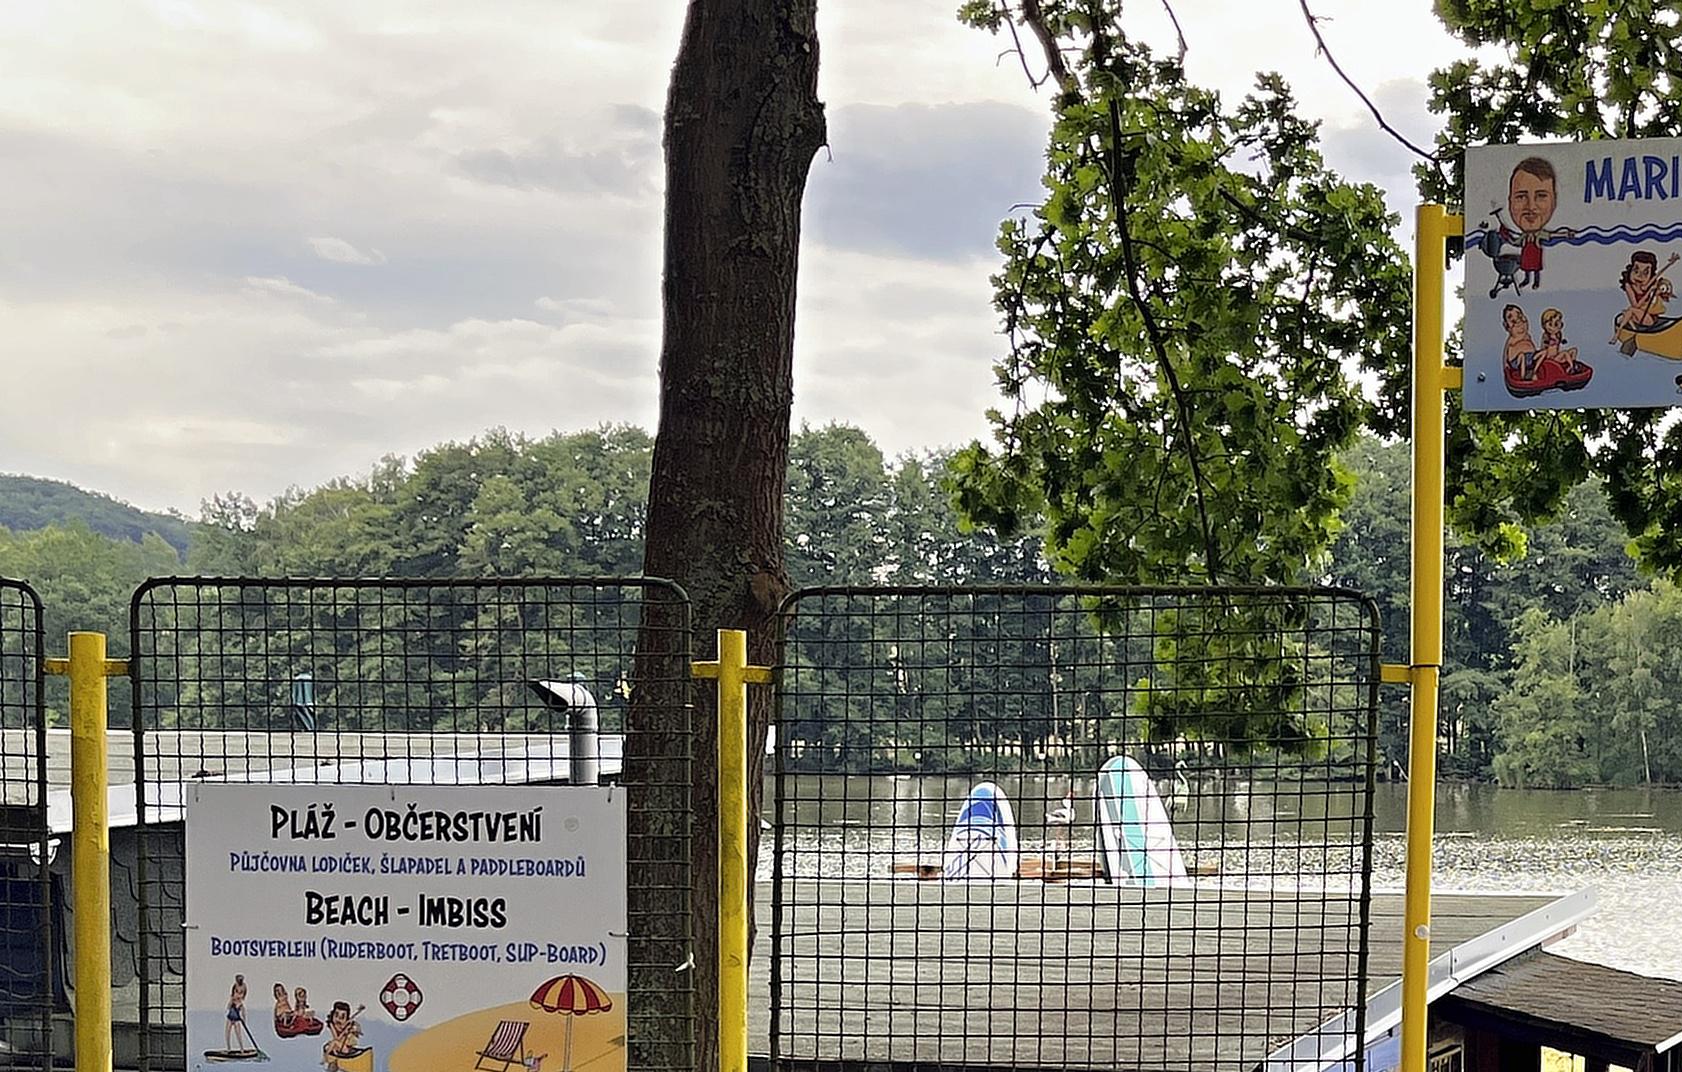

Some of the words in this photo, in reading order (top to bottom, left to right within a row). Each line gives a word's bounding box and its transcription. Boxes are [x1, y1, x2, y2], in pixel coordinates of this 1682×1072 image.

[270, 802, 336, 840] PLÁŽ
[365, 803, 543, 842] OBČERSTVENÍ
[229, 850, 307, 874] PŮJČOVNA
[312, 854, 376, 875] LODIČEK,
[380, 854, 453, 877] ŠLAPADEL
[456, 857, 467, 876] A
[470, 856, 586, 878] PADDLEBOARDŮ
[305, 891, 389, 926] BEACH
[418, 893, 507, 928] IMBISS
[211, 936, 317, 958] BOOTSVERLEIH
[321, 940, 419, 962] (RUDERBOOT,
[422, 942, 501, 964] TRETBOOT,
[506, 942, 606, 966] SUP-BOARD)
